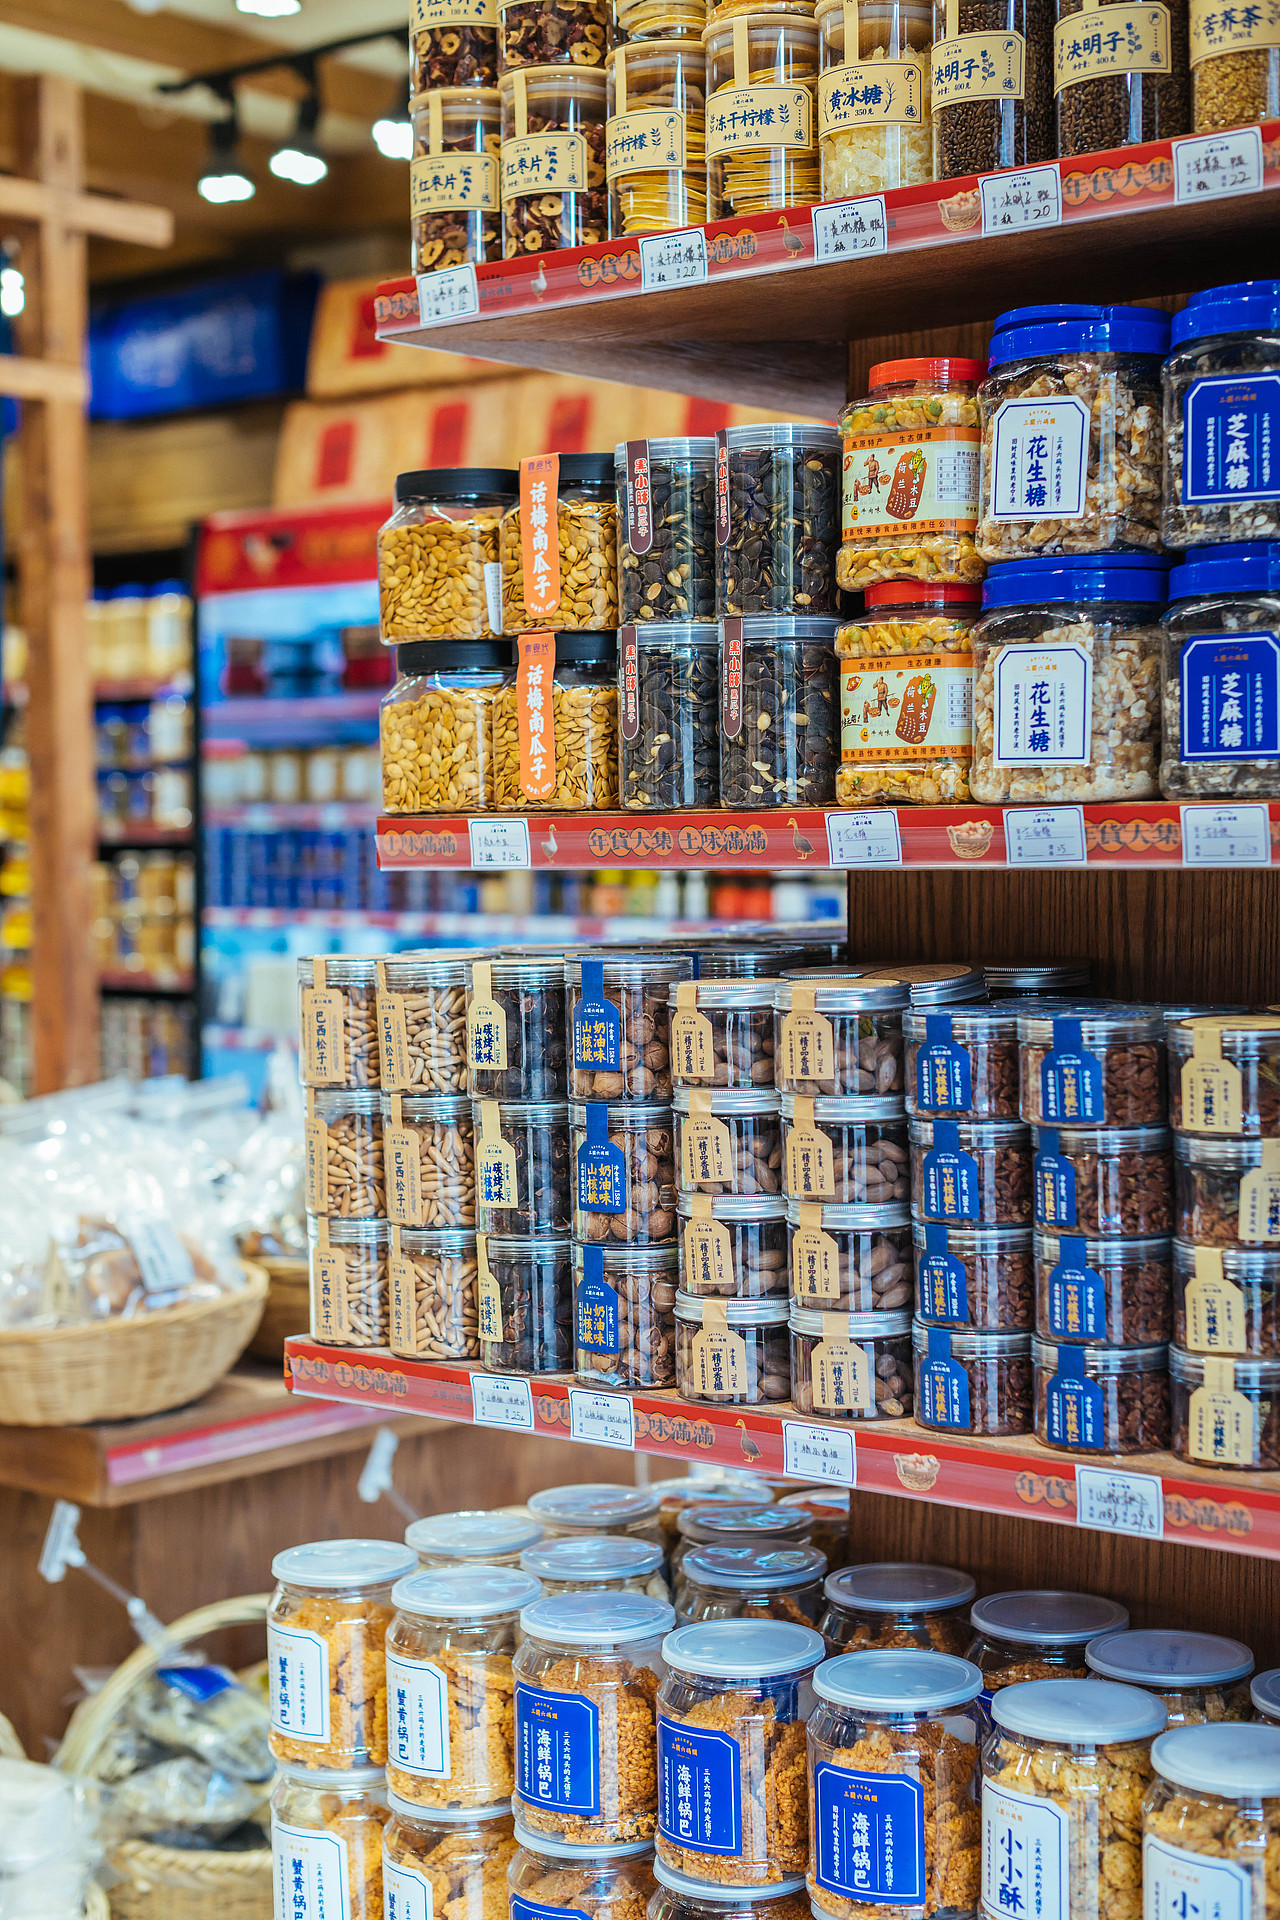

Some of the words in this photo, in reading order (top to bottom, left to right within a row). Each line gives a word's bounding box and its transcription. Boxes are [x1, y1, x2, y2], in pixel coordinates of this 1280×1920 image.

[1203, 5, 1264, 38] 苦荞茶
[1066, 31, 1126, 62] 决明子
[934, 58, 980, 86] 决明子
[829, 84, 884, 112] 黄冰糖
[716, 108, 777, 132] 冻干柠檬
[419, 174, 457, 192] 红枣片
[506, 154, 543, 177] 红枣片
[1064, 159, 1173, 198] 年貨大集
[1230, 172, 1252, 186] 22
[1033, 205, 1050, 218] 20
[862, 237, 876, 248] 20
[577, 251, 641, 284] 年貨大
[683, 266, 696, 278] 20
[852, 438, 883, 448] 高原特产
[899, 432, 932, 444] 生态健康
[1225, 412, 1250, 490] 芝麻糖
[634, 457, 649, 506] 黑小胖
[718, 446, 728, 495] 黑小胖
[1024, 434, 1048, 508] 花生糖
[530, 481, 551, 598] 话梅南瓜子
[626, 644, 637, 691] 黑小胖
[728, 640, 741, 688] 黑小胖
[859, 661, 892, 670] 高原特产
[908, 658, 942, 668] 生态健康
[526, 664, 547, 780] 话梅南瓜子
[1028, 680, 1051, 752] 花生糖
[1219, 672, 1244, 748] 芝麻糖
[384, 834, 457, 855] 土味滿滿
[588, 831, 673, 851] 年貨大集
[680, 830, 768, 851] 土味滿滿
[315, 1010, 327, 1065] 巴西松子
[383, 1016, 395, 1072] 巴西松子
[474, 1023, 484, 1064] 山核桃
[483, 1022, 496, 1064] 碳烤味
[580, 1020, 594, 1062] 山核桃
[593, 1020, 608, 1064] 奶油味
[684, 1036, 694, 1074] 精品香榧
[800, 1036, 810, 1076] 精品香榧
[935, 1064, 950, 1106] 山核桃仁
[1063, 1074, 1078, 1118] 山核桃仁
[394, 1152, 406, 1207] 巴西松子
[492, 1160, 506, 1202] 碳烤味
[698, 1142, 710, 1180] 精品香榧
[802, 1153, 812, 1192] 精品香榧
[484, 1162, 494, 1202] 山核桃
[586, 1163, 600, 1204] 山核桃
[598, 1163, 613, 1206] 奶油味
[942, 1173, 957, 1214] 山核桃仁
[1044, 1178, 1056, 1222] 山核桃仁
[700, 1242, 712, 1280] 精品香榧
[808, 1254, 817, 1294] 精品香榧
[321, 1270, 332, 1324] 巴西松子
[394, 1280, 402, 1335] 巴西松子
[934, 1276, 946, 1317] 山核桃仁
[1066, 1290, 1080, 1334] 山核桃仁
[582, 1304, 594, 1344] 山核桃
[593, 1304, 606, 1346] 奶油味
[334, 1366, 408, 1395] 土味滿滿
[711, 1352, 724, 1390] 精品香榧
[832, 1366, 845, 1406] 精品香榧
[538, 1399, 571, 1420] 年貨
[935, 1380, 948, 1422] 山核桃仁
[634, 1414, 714, 1446] 土味滿滿
[1066, 1400, 1080, 1444] 山核桃仁
[1165, 1495, 1250, 1534] 味滿滿
[278, 1656, 290, 1725] 蟹黄锅巴
[397, 1688, 409, 1760] 蟹黄锅巴
[536, 1728, 552, 1799] 海鲜锅巴
[677, 1764, 692, 1838] 海鲜锅巴
[852, 1812, 870, 1888] 海鲜锅巴
[999, 1828, 1025, 1913] 小小酥
[292, 1858, 307, 1920] 蟹黄锅巴
[1172, 1890, 1200, 1920] 小
